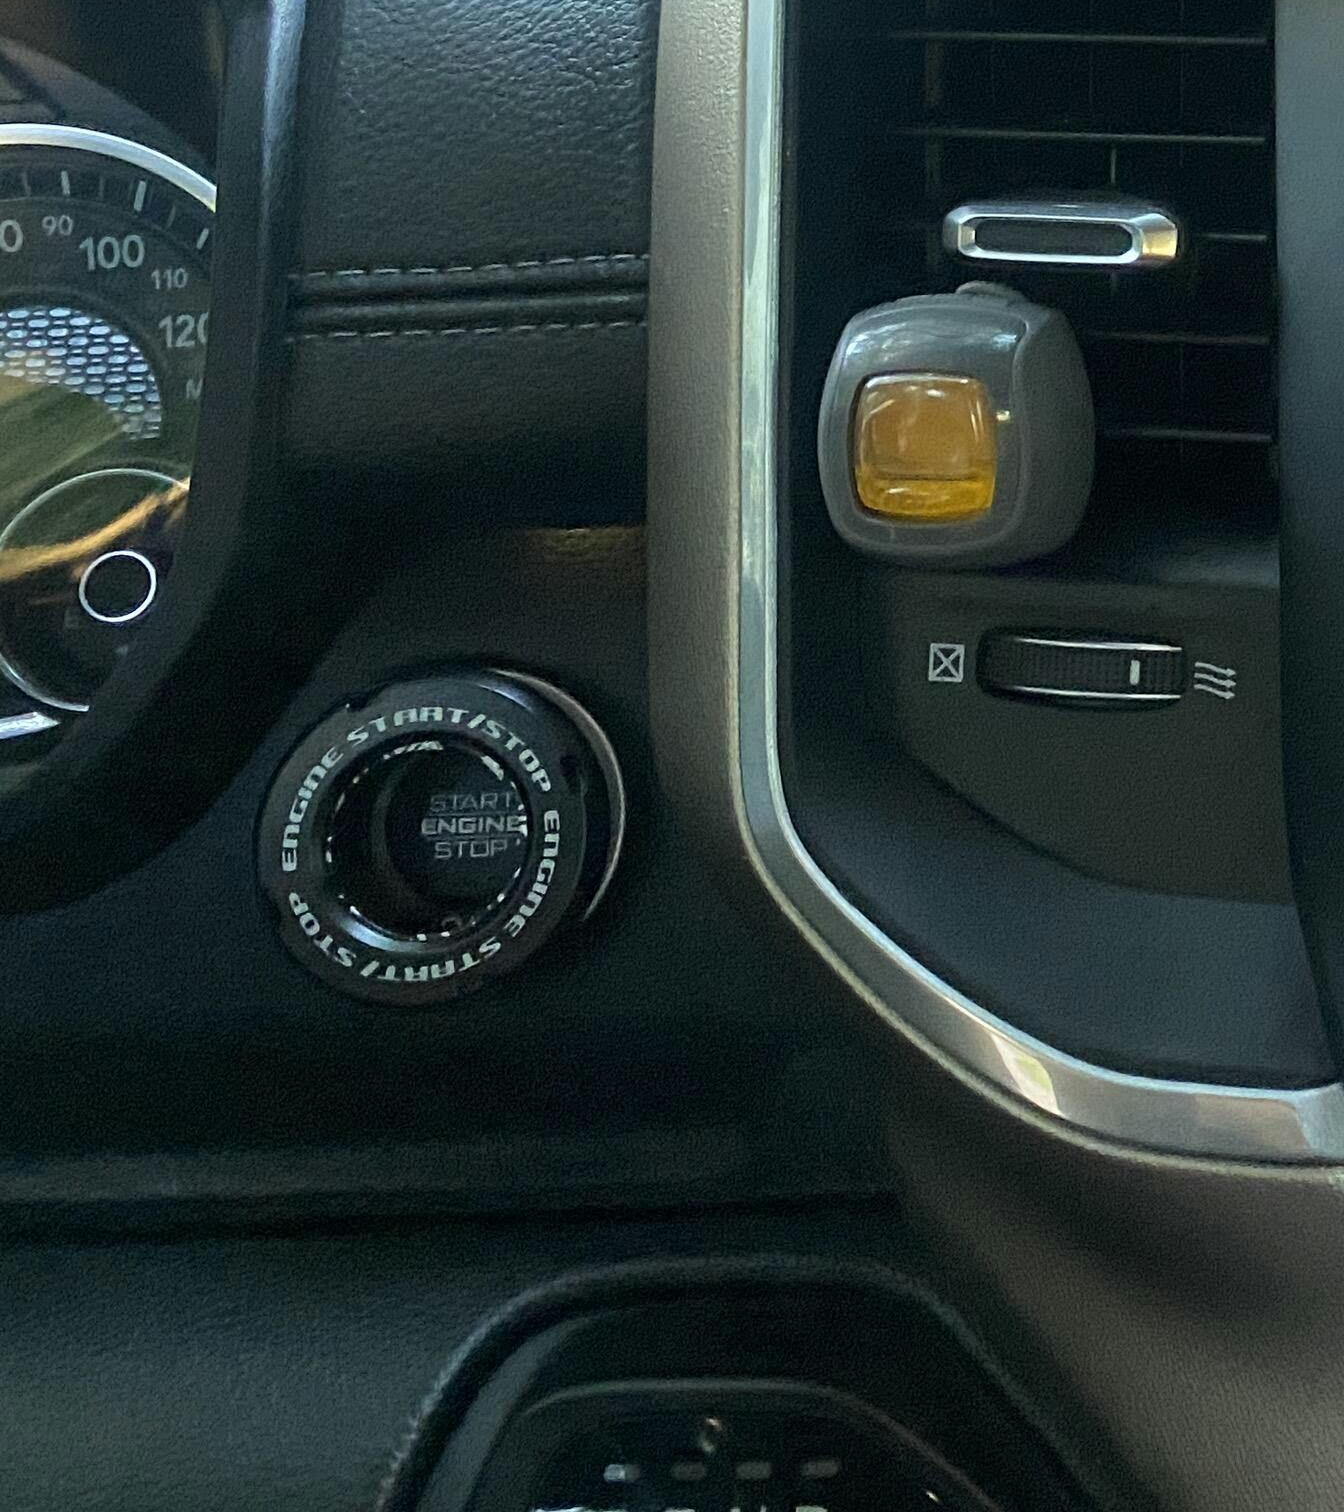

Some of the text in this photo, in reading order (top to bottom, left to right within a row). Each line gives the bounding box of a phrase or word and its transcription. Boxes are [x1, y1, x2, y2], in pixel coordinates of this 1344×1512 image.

[42, 214, 74, 237] 90
[79, 234, 146, 271] 100
[151, 267, 189, 290] 110
[430, 791, 514, 812] START
[421, 815, 522, 836] ENGINE
[434, 838, 509, 860] STOP
